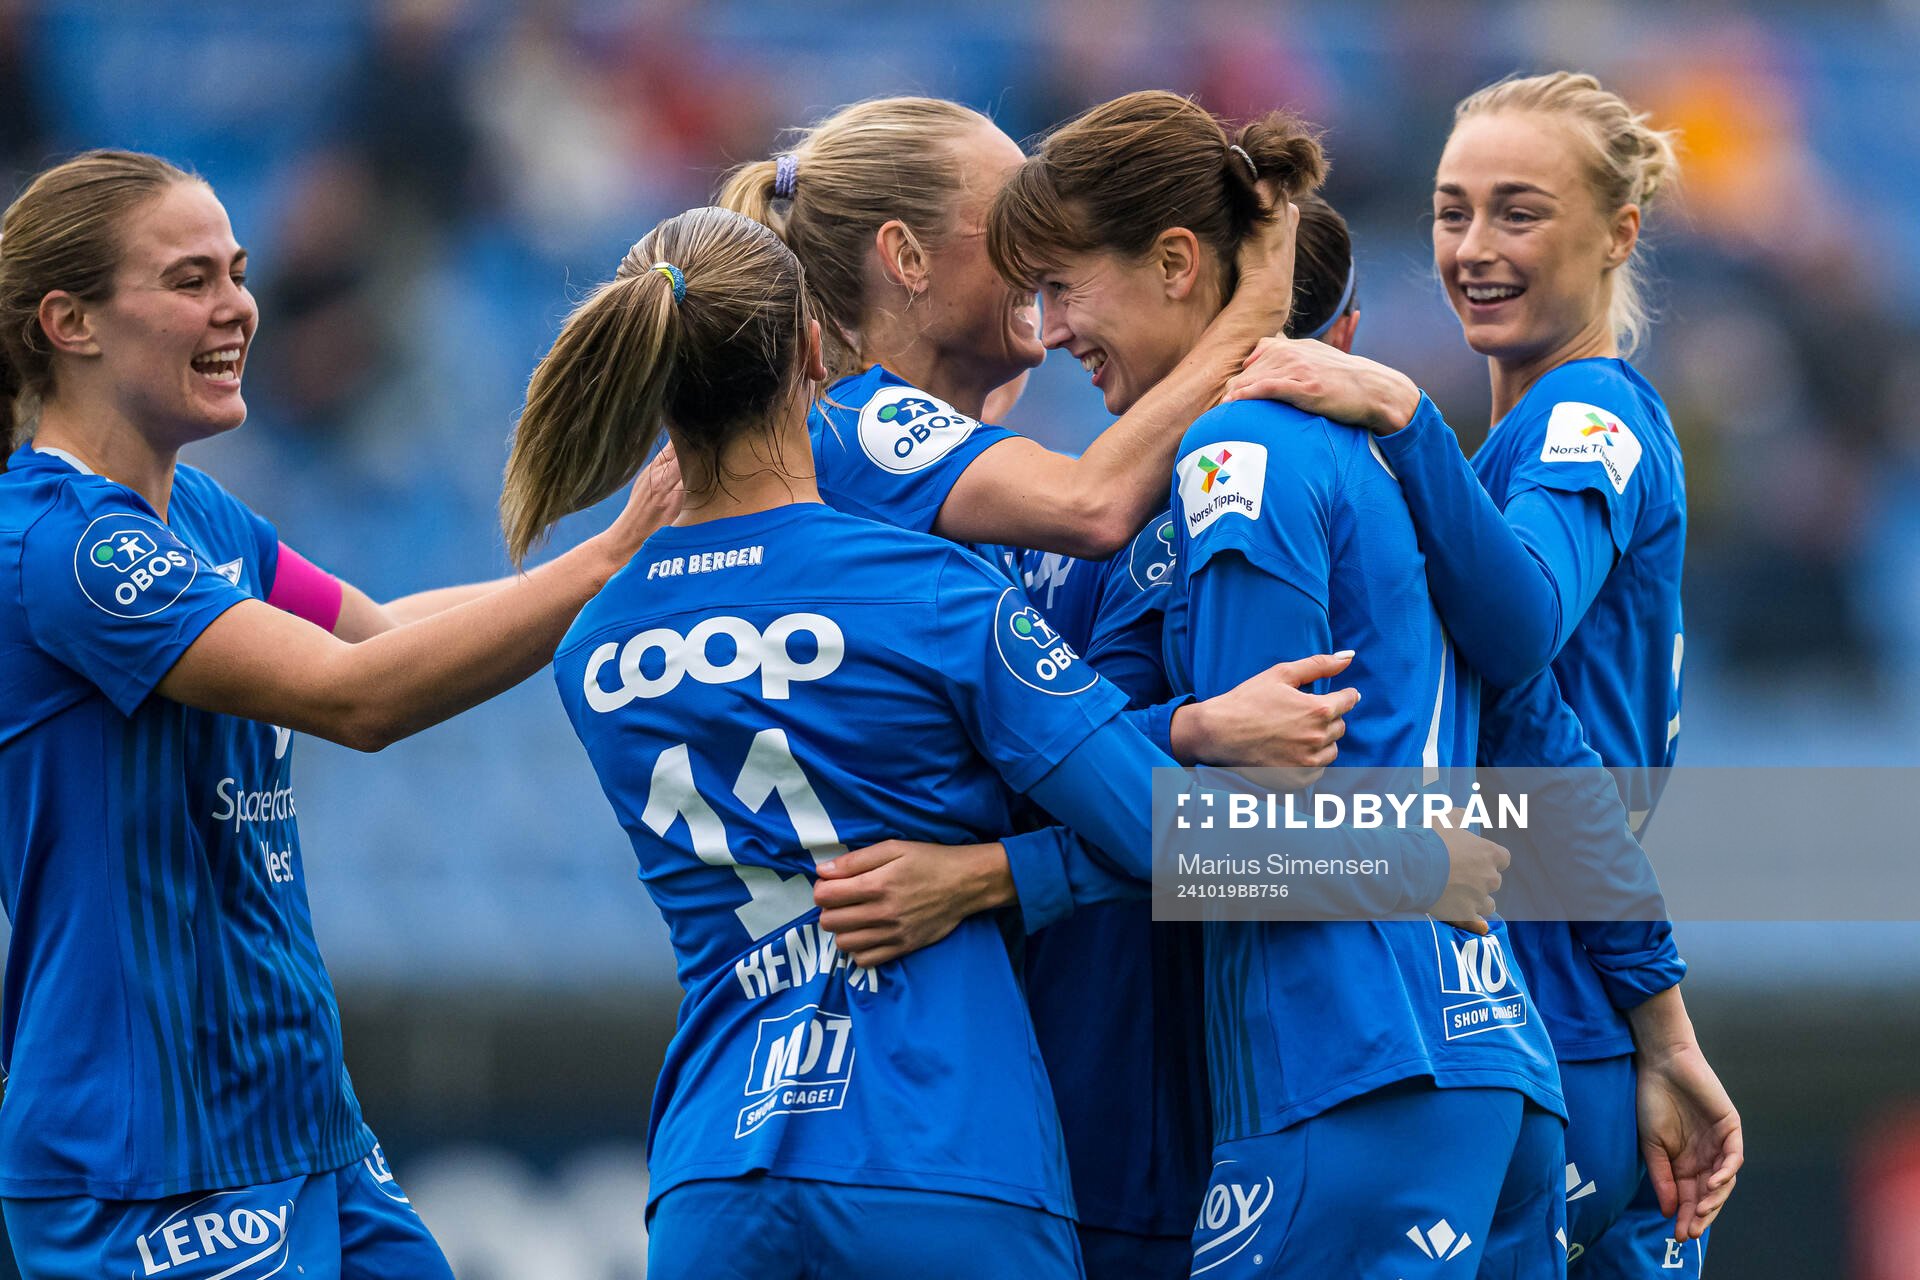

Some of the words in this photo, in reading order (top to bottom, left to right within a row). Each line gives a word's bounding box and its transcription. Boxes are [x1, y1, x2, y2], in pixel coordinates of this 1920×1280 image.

[1549, 444, 1588, 455] Norsk
[1189, 503, 1213, 526] Norsk
[1214, 492, 1253, 511] Tipping
[115, 551, 187, 605] OBOS
[647, 557, 685, 580] FOR
[688, 545, 764, 574] BERGEN
[584, 612, 845, 713] coop
[641, 728, 850, 942] 11
[1454, 1008, 1489, 1029] SHOW
[136, 1205, 287, 1276] LERØY
